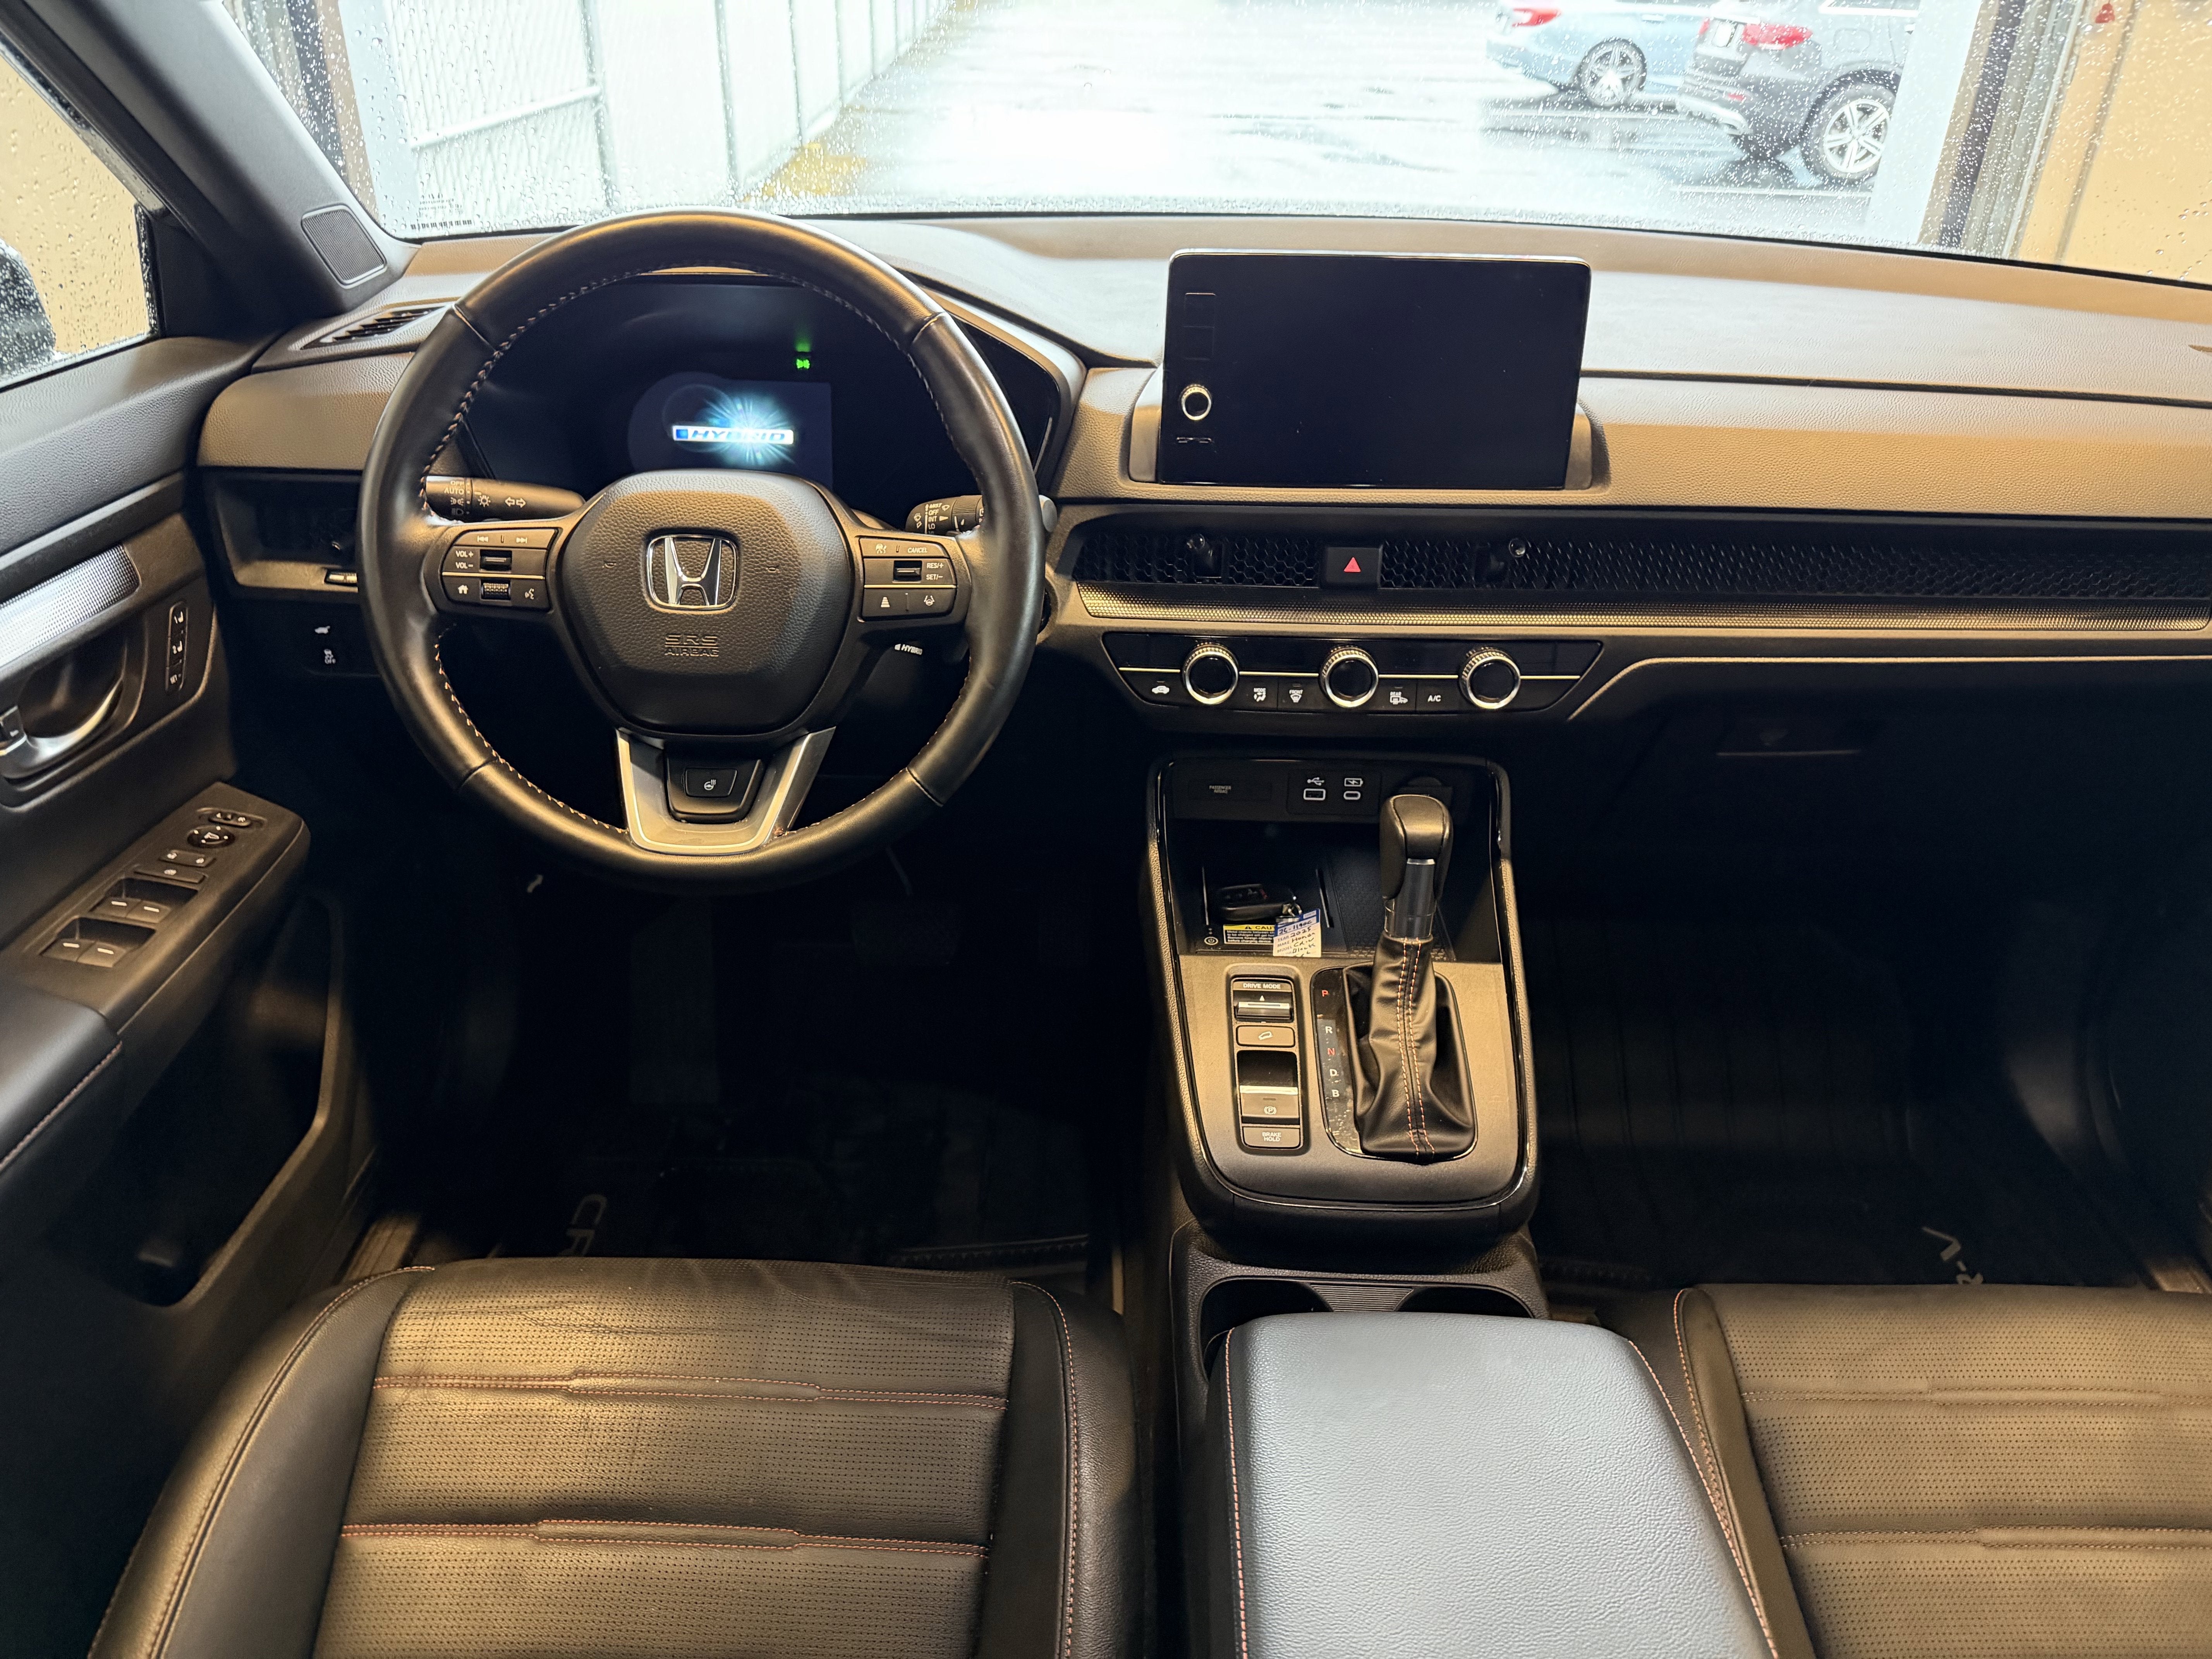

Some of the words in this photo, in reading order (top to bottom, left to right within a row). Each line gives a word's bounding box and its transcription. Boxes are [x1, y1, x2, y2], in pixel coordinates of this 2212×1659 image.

[665, 633, 718, 646] SRS
[665, 648, 720, 657] AIRBAG
[1290, 926, 1311, 937] 2025
[1292, 933, 1315, 943] Honda
